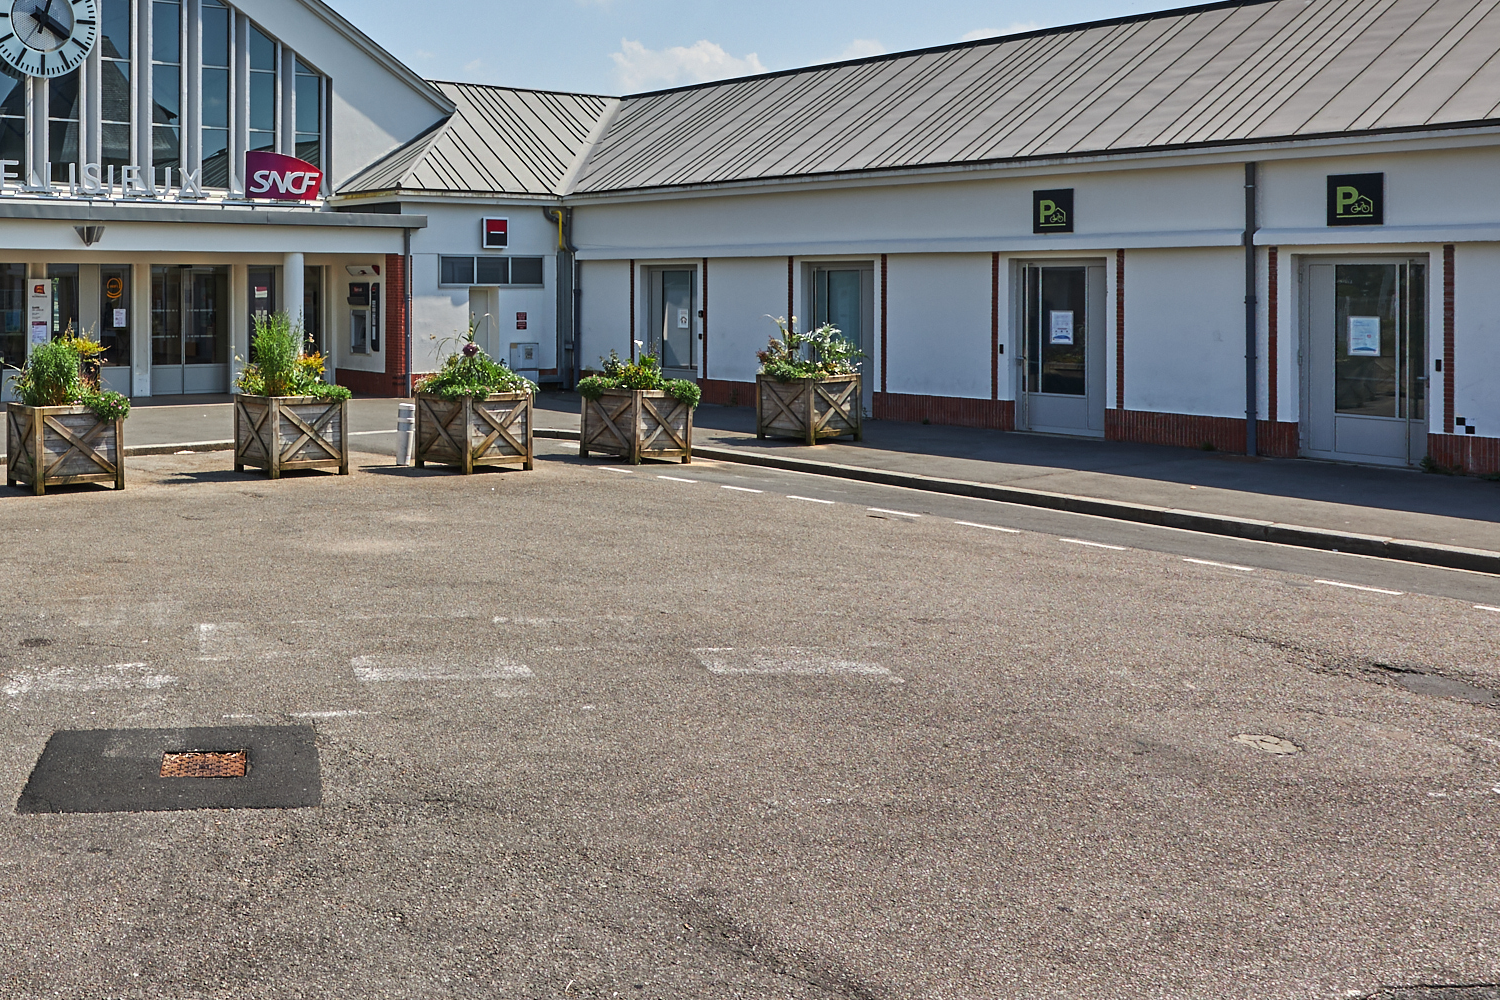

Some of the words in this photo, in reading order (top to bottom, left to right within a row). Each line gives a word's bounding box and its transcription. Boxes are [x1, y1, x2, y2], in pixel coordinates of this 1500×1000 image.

[44, 161, 202, 198] LISIEUX
[249, 170, 320, 194] SNCF
[1039, 199, 1056, 223] P
[1336, 186, 1359, 214] P
